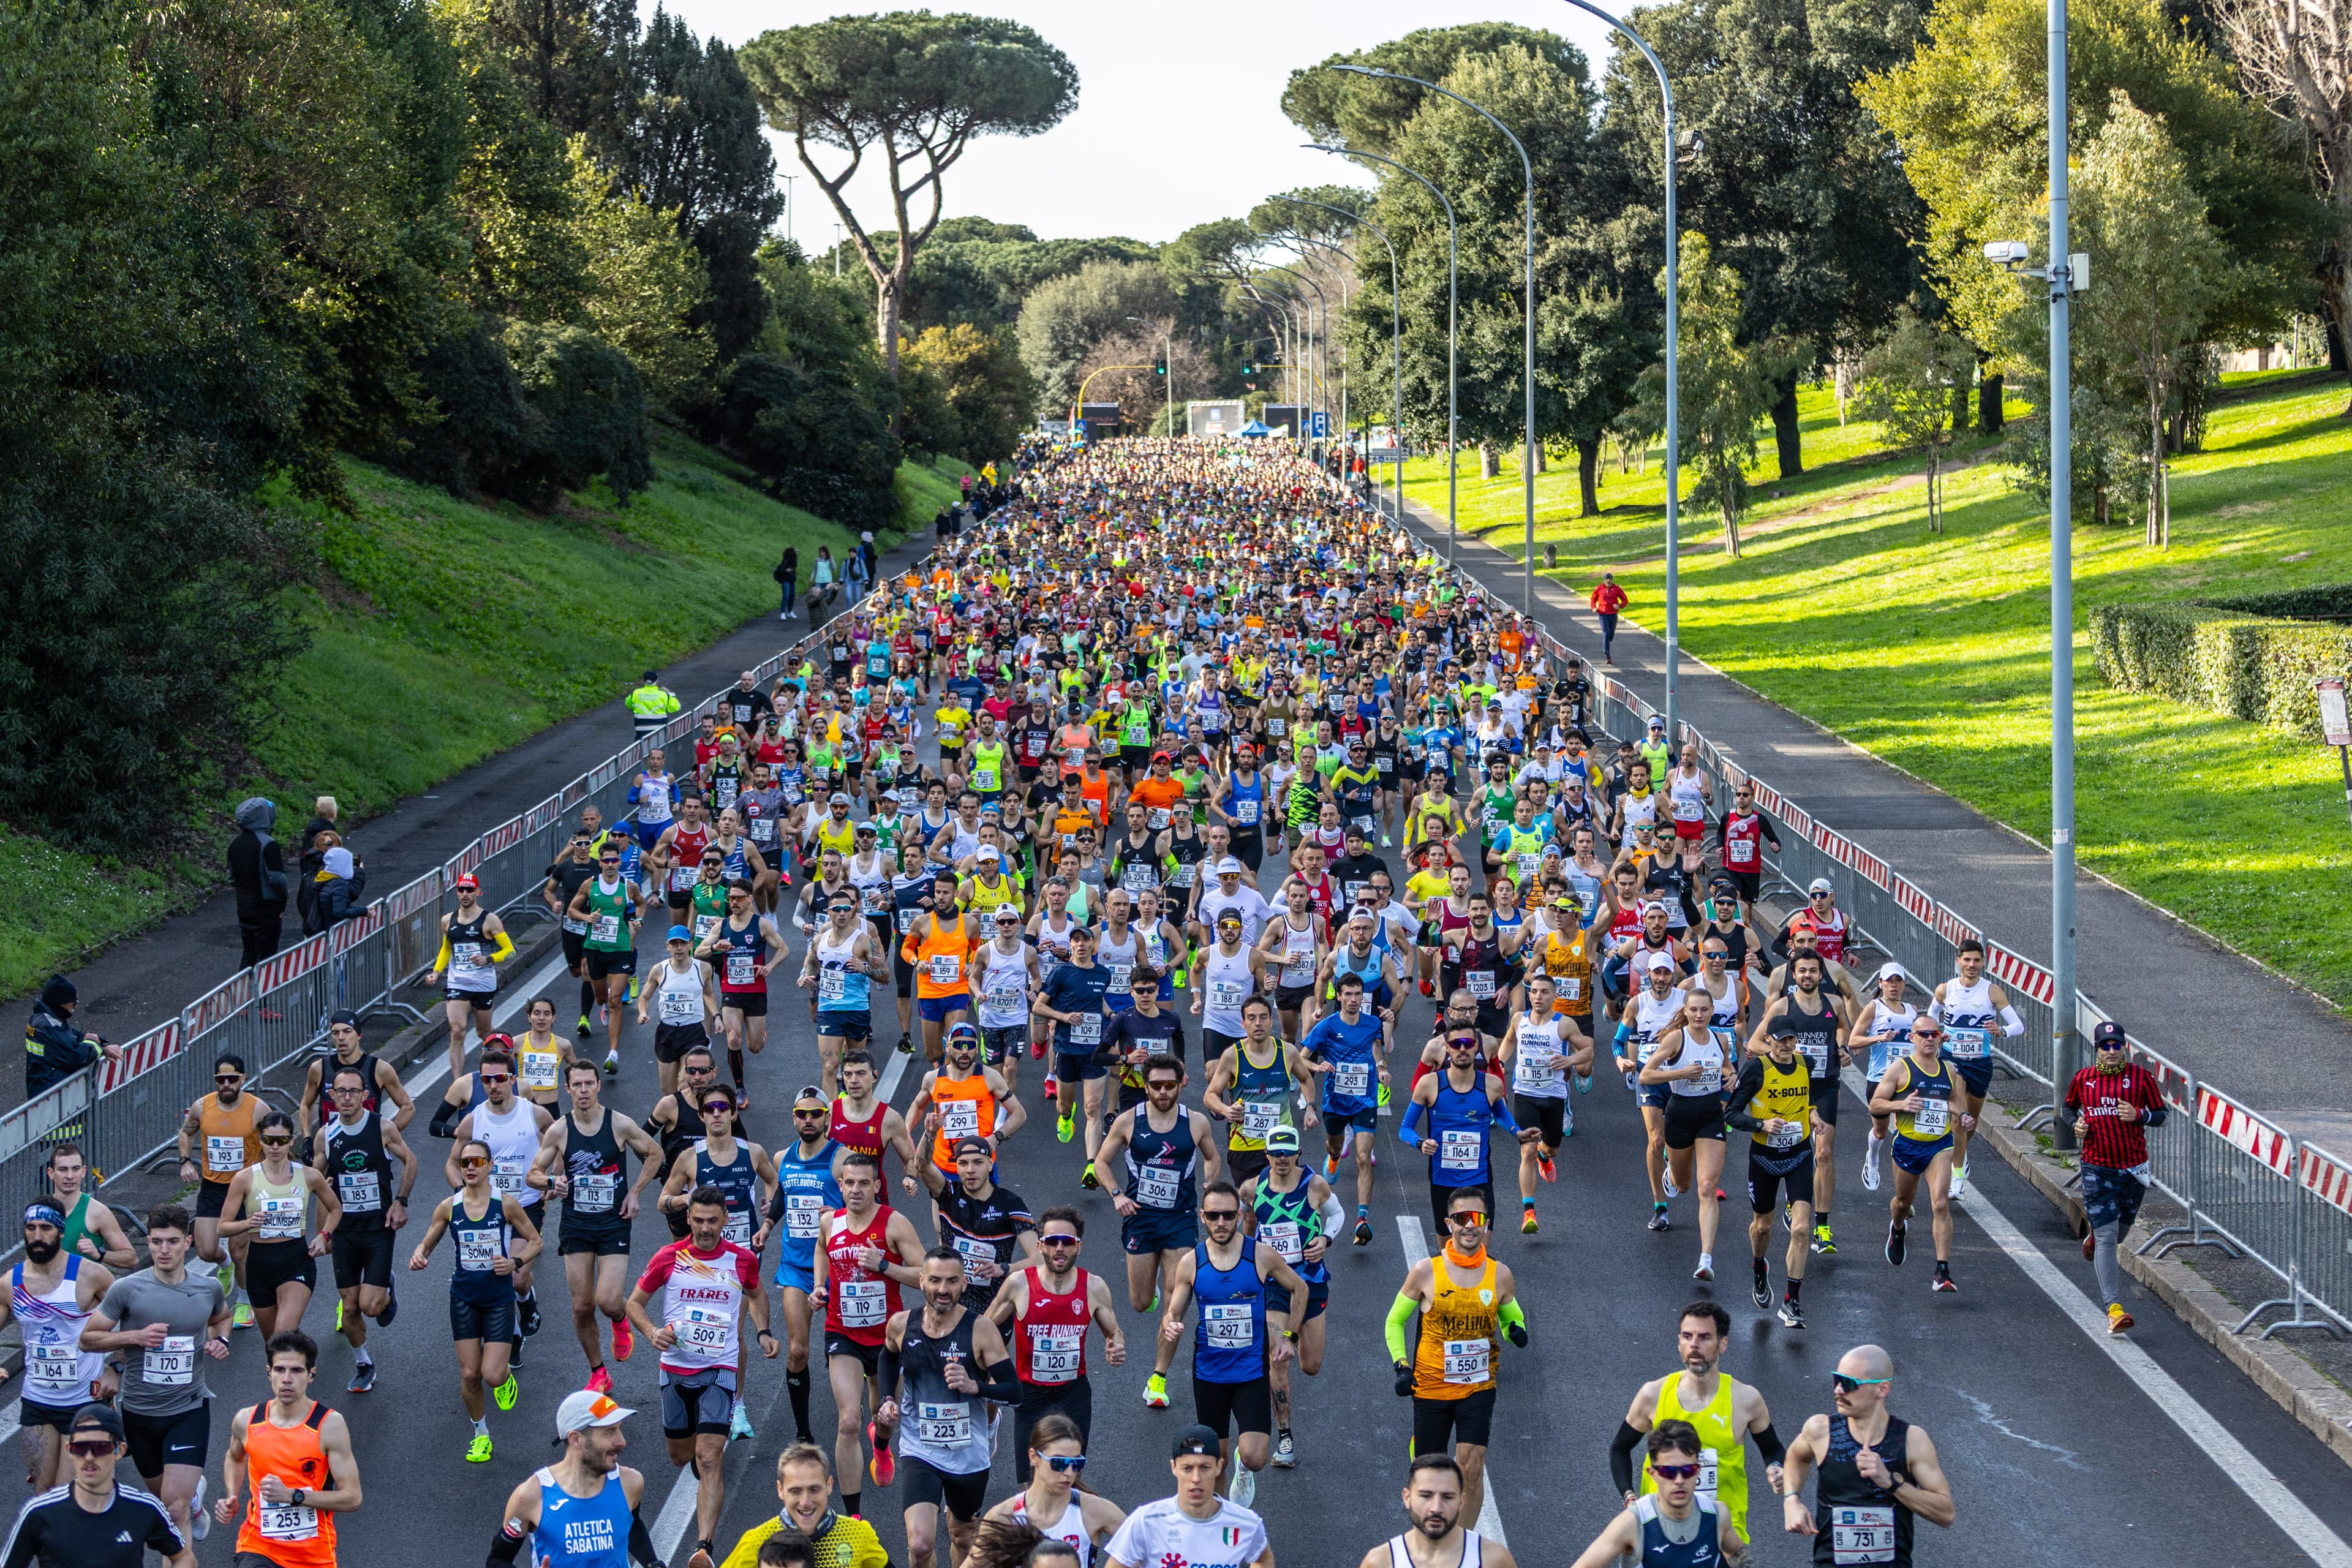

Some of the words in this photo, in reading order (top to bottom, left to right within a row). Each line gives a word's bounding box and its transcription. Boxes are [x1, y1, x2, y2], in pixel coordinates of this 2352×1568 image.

[1112, 976, 1123, 985] 106
[825, 982, 836, 991] 273
[1472, 984, 1488, 992] 1203
[997, 998, 1013, 1006] 8707
[1221, 995, 1232, 1003] 188
[1960, 1044, 1975, 1053] 1104
[1531, 1069, 1542, 1079] 115
[1344, 1077, 1359, 1086] 293
[1768, 1086, 1808, 1099] X-SOLID
[2101, 1096, 2116, 1106] Fly
[951, 1117, 967, 1128] 299
[1254, 1118, 1270, 1128] 287
[1925, 1114, 1940, 1123] 286
[1776, 1137, 1793, 1147] 304
[218, 1151, 232, 1161] 193
[1452, 1146, 1470, 1158] 1164
[495, 1178, 510, 1189] 185
[352, 1189, 367, 1201] 183
[1148, 1183, 1166, 1197] 306
[587, 1191, 599, 1201] 113
[797, 1214, 812, 1225] 132
[722, 1229, 737, 1240] 167
[1271, 1240, 1288, 1253] 569
[468, 1248, 494, 1259] SOMMI
[855, 1302, 870, 1314] 119
[1444, 1314, 1487, 1331] Melilli
[1027, 1324, 1049, 1337] FREE
[1219, 1324, 1239, 1335] 297
[693, 1328, 715, 1343] 509
[160, 1357, 178, 1370] 170
[1047, 1356, 1065, 1369] 120
[1458, 1359, 1477, 1372] 550
[45, 1365, 62, 1378] 164
[933, 1425, 956, 1438] 223
[277, 1512, 302, 1528] 253
[565, 1519, 613, 1538] ATLETICA
[565, 1535, 614, 1555] SABATINA
[1853, 1532, 1875, 1548] 731
